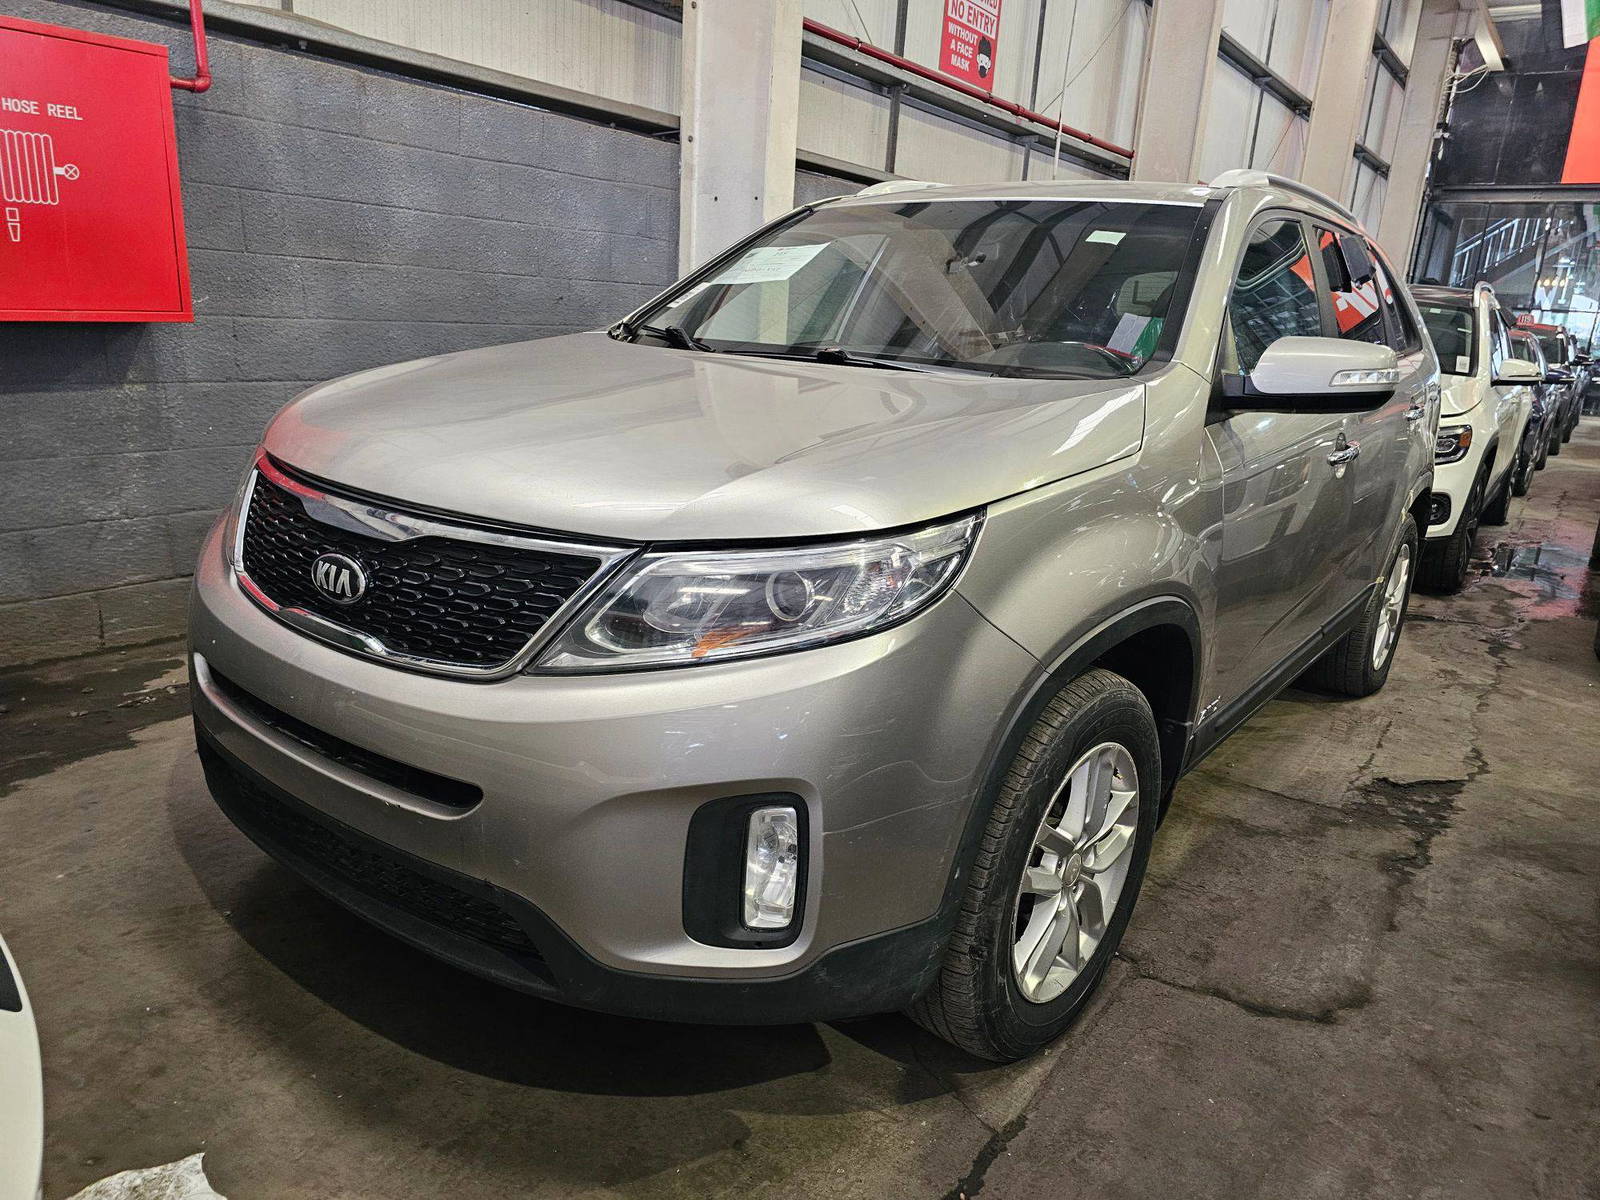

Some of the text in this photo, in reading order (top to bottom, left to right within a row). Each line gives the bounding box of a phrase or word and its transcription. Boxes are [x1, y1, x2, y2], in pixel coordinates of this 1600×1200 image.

[951, 0, 995, 36] NO ENTRY
[948, 21, 978, 46] WITHOUT
[950, 39, 974, 59] A FACE
[951, 54, 970, 72] MASK
[1, 96, 84, 121] HOSE REEL
[316, 560, 352, 597] KIA
